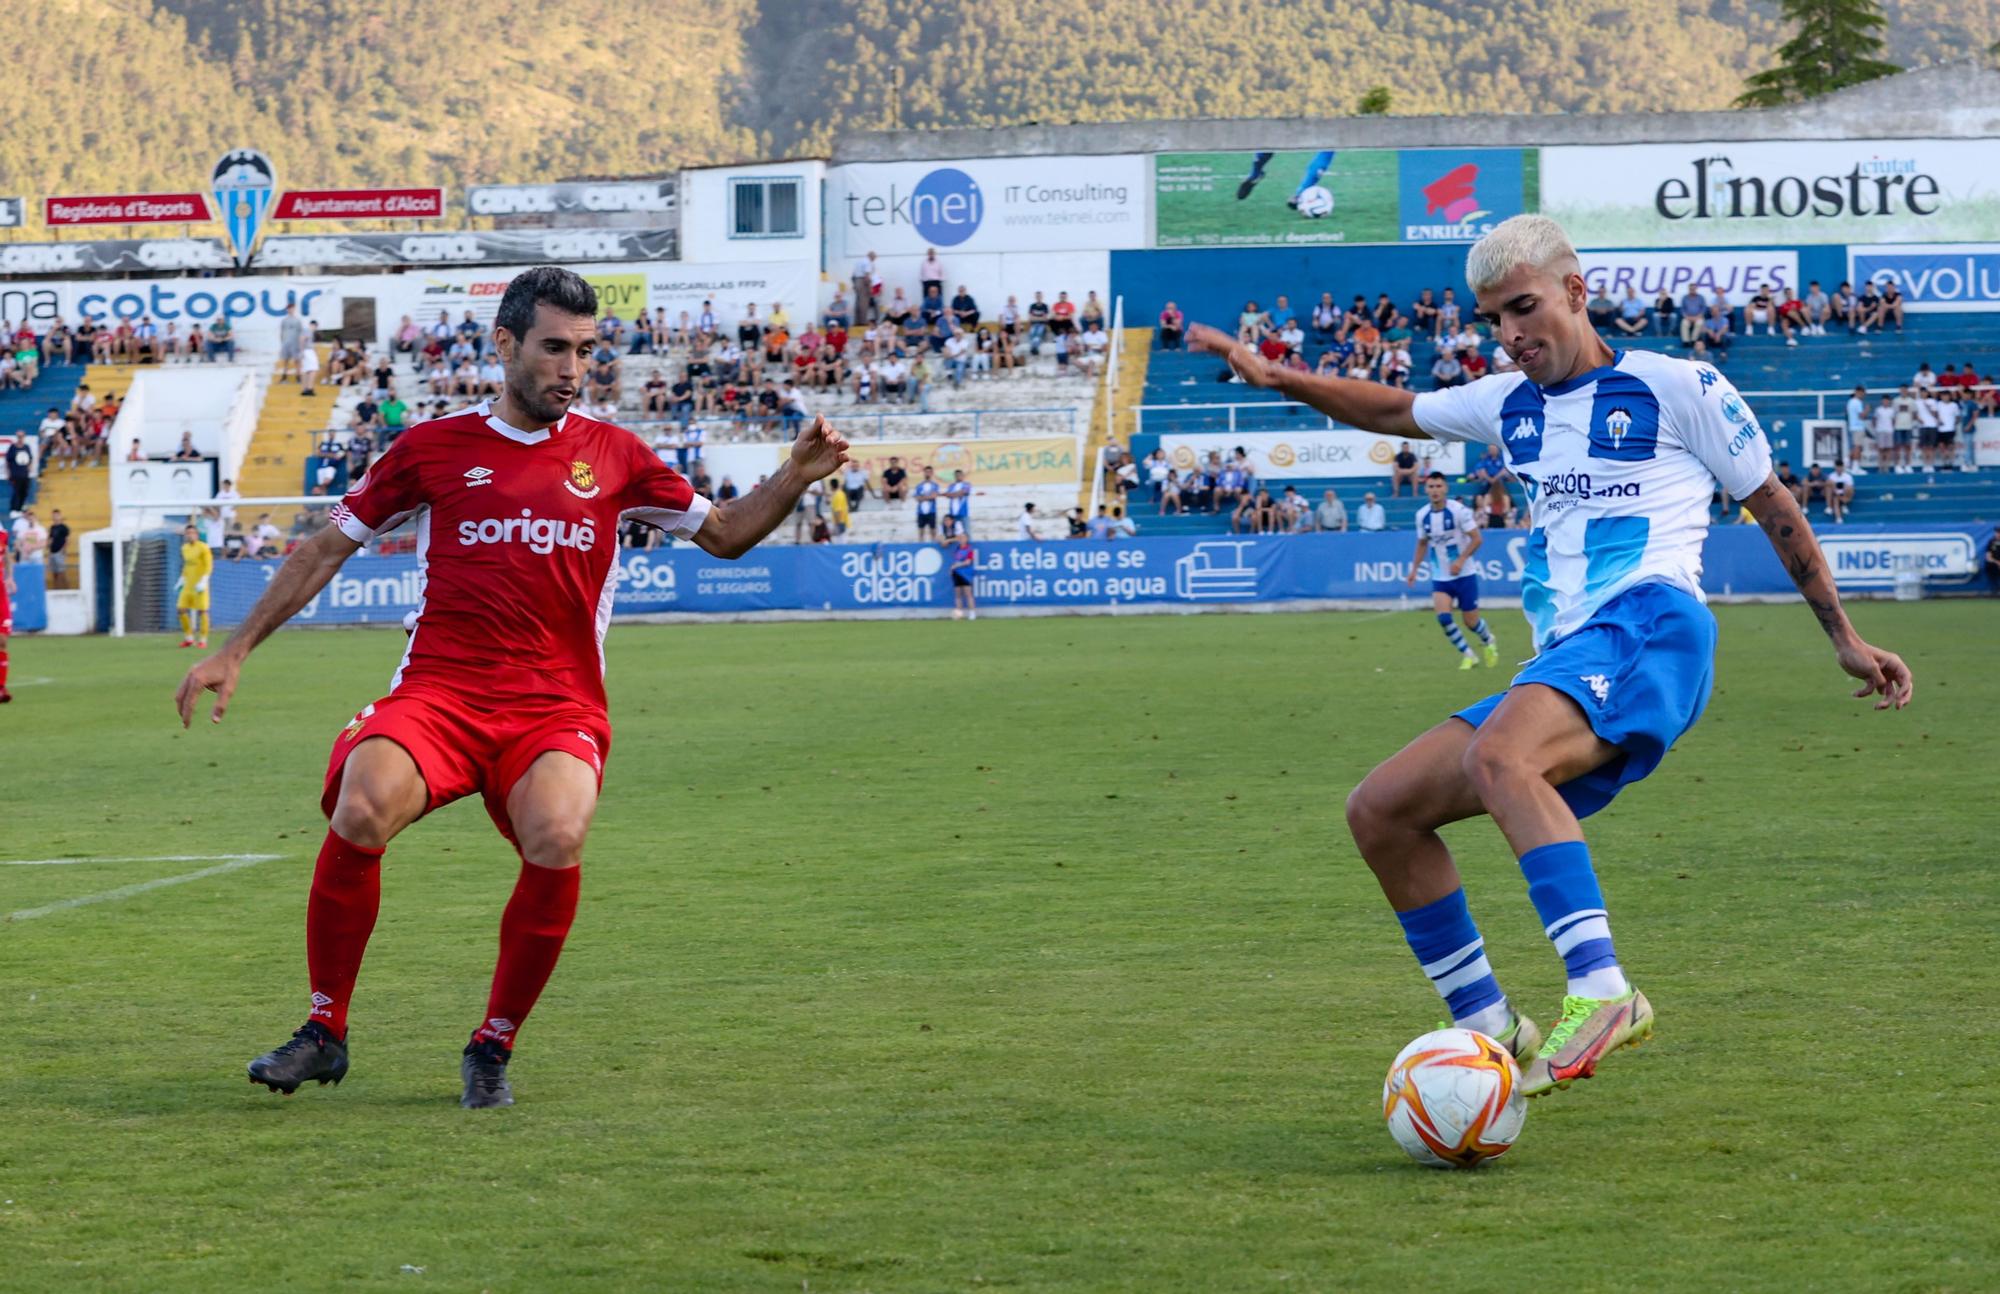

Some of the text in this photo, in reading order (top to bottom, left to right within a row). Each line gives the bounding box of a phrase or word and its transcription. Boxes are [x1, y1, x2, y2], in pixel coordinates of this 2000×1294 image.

[1862, 155, 1916, 174] ciutat
[846, 183, 979, 227] teknei
[1004, 184, 1128, 205] IT Consulting
[125, 200, 193, 218] d'Esports
[292, 196, 436, 216] Ajuntament d'Alcoi
[1004, 209, 1130, 227] www.teknei.com
[653, 280, 734, 292] MASCARILLAS
[1585, 265, 1786, 296] GRUPAJES
[78, 284, 322, 321] cotopur
[975, 451, 1073, 471] NATURA
[1299, 442, 1351, 463] aitex
[466, 478, 492, 488] umbro
[842, 550, 914, 580] aqua
[973, 548, 1146, 573] La tela que se
[697, 581, 772, 595] DE SEGUROS
[854, 577, 932, 603] clean
[974, 575, 1167, 600] limpia con agua
